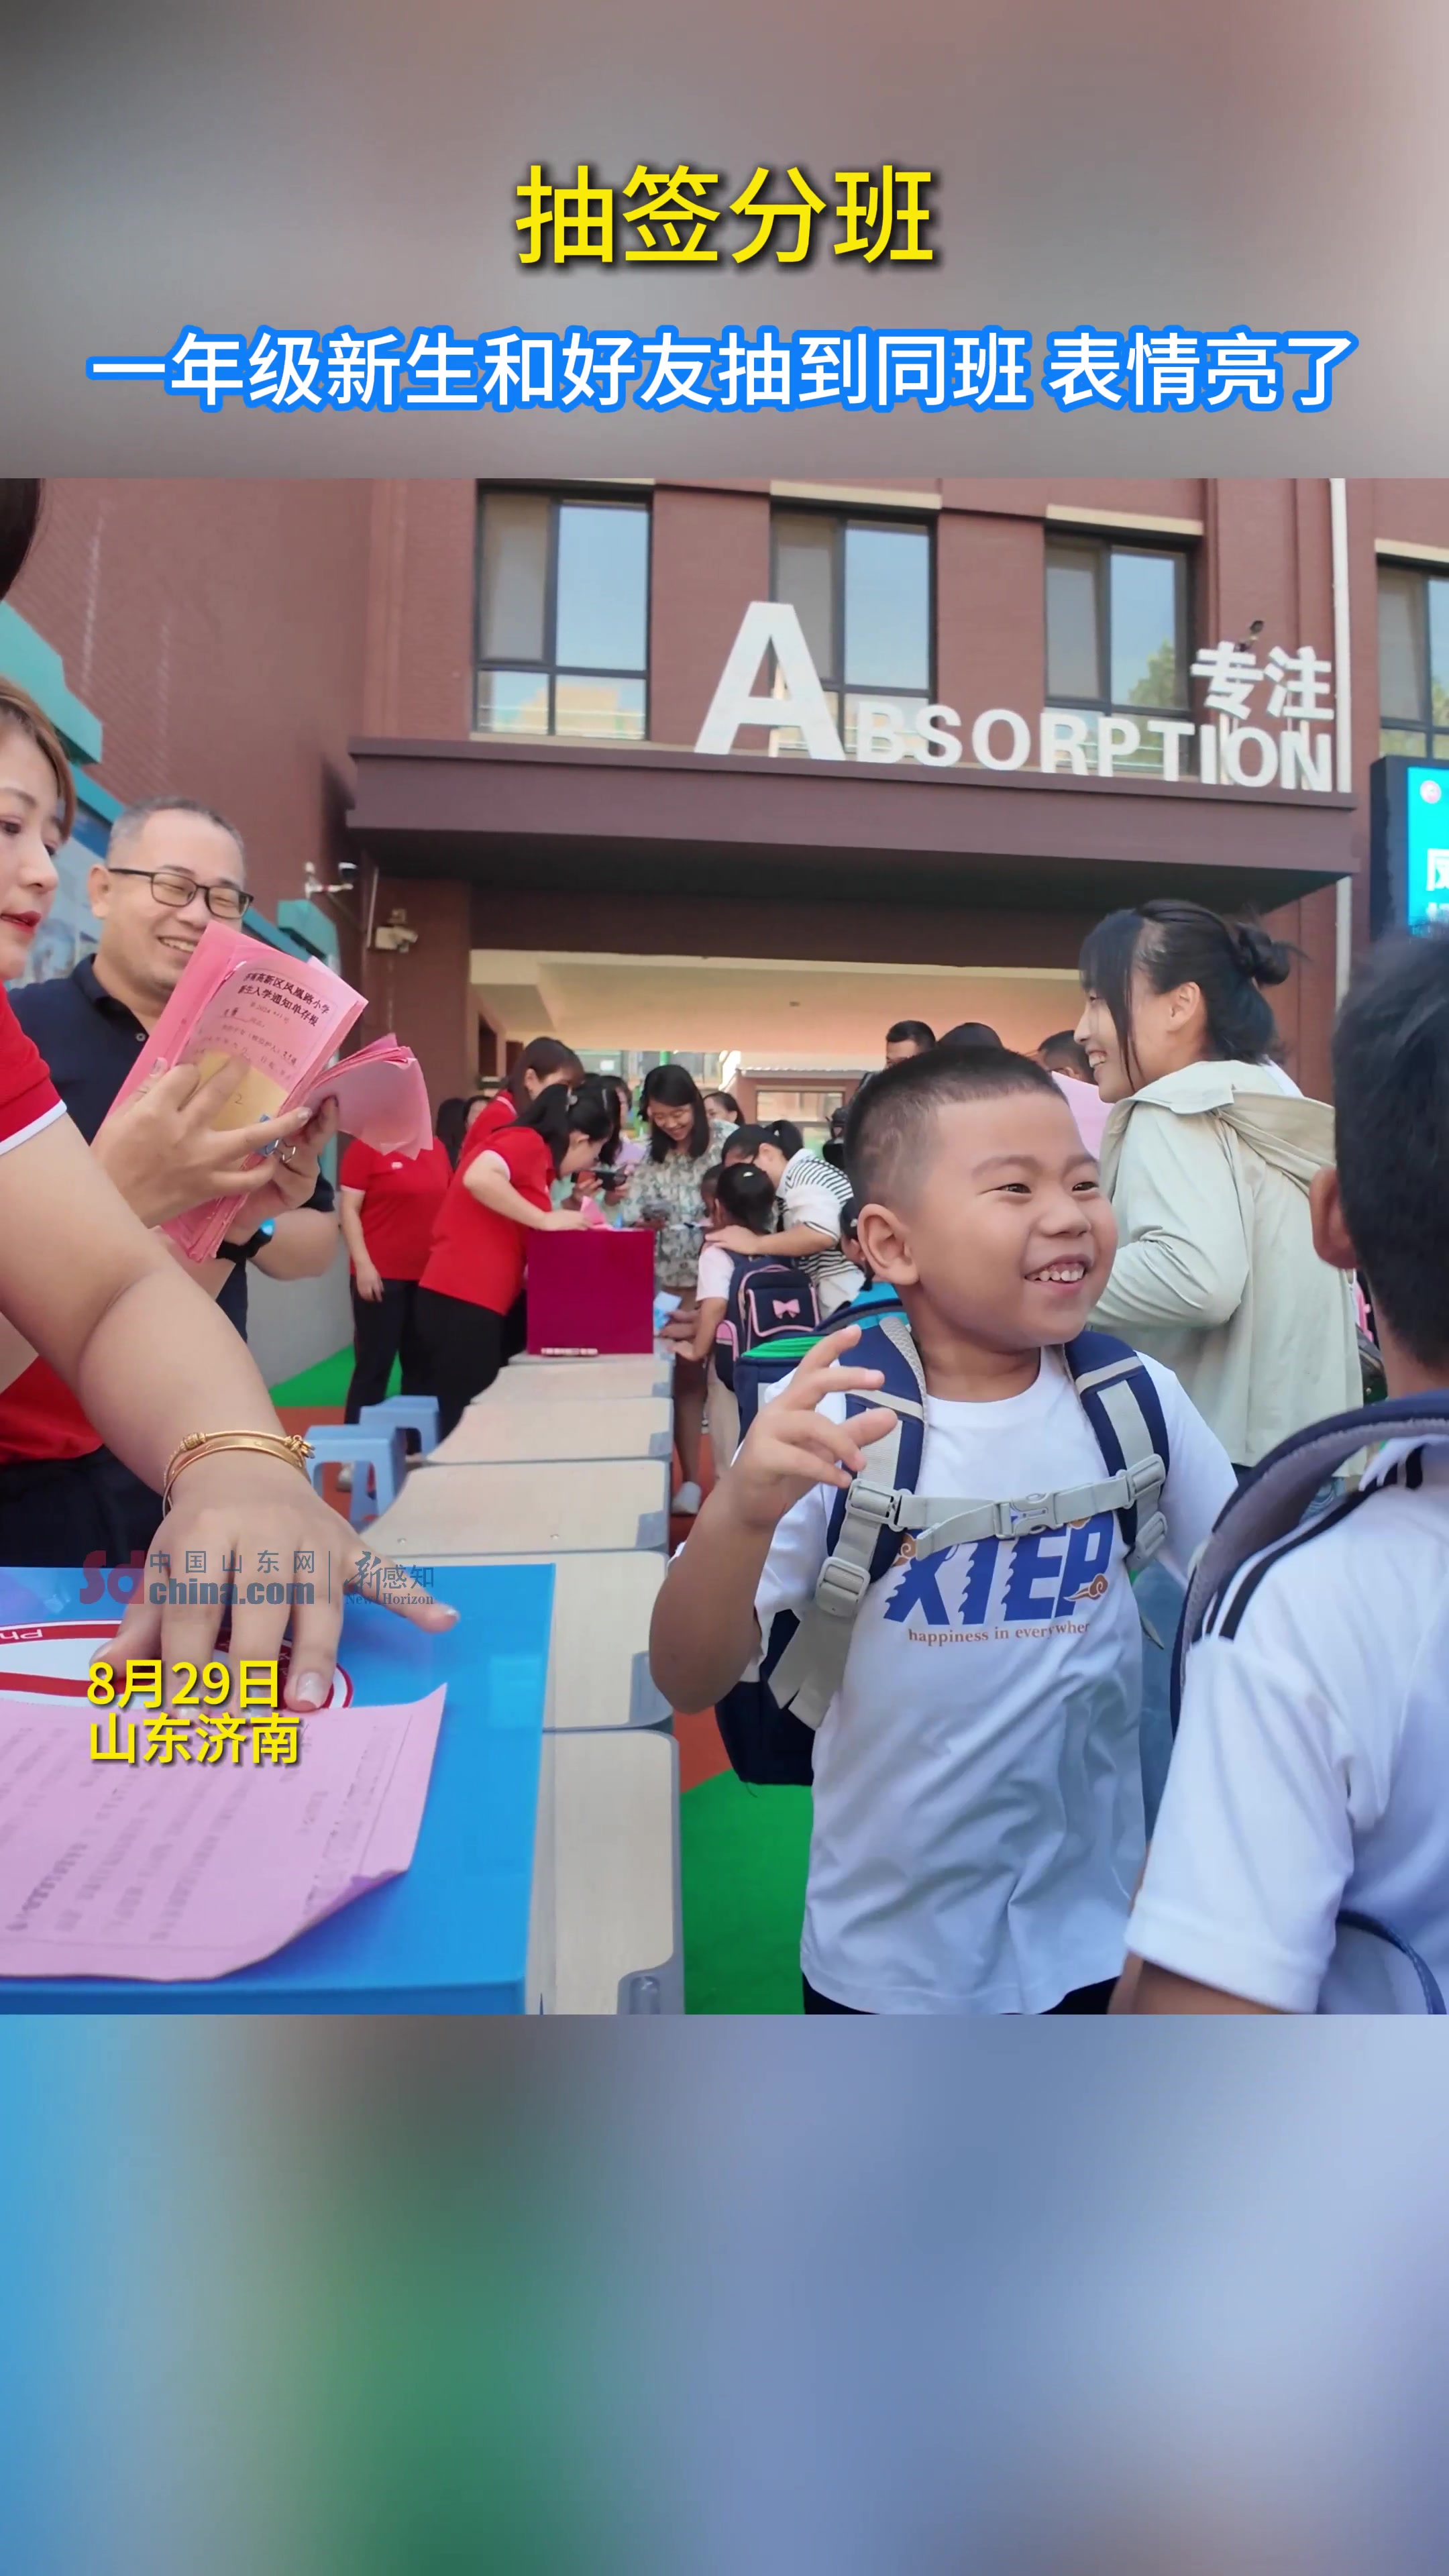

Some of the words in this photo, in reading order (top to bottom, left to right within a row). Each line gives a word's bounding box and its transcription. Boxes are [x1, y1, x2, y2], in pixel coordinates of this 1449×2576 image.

[694, 601, 1333, 793] ABSORPTION
[1190, 641, 1335, 720] 专注
[908, 1628, 989, 1647] happiness
[994, 1626, 1009, 1639] in
